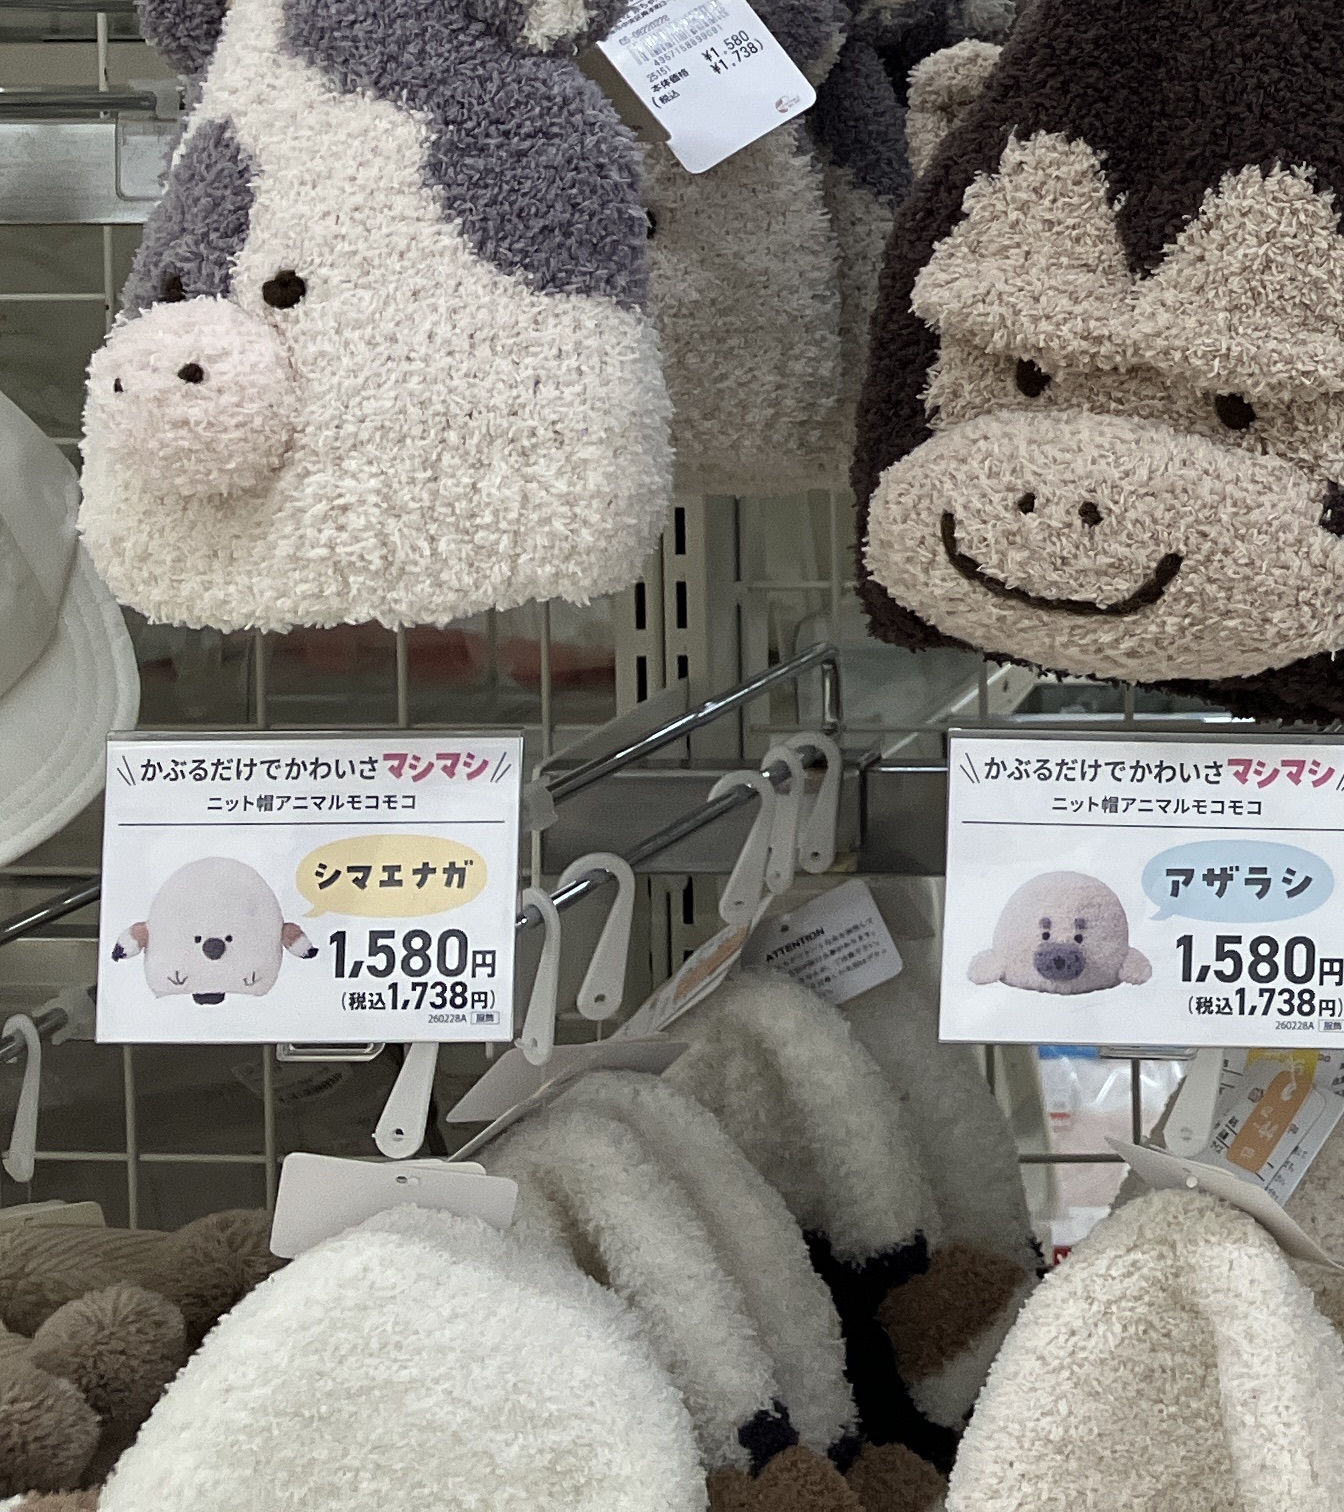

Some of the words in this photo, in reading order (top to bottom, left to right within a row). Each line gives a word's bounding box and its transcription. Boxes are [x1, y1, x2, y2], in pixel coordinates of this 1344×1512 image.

[140, 752, 490, 783] かぶるだけでかわいさマシマシ
[984, 757, 1336, 788] かぶるだけでかわいさマシマシ
[207, 795, 416, 812] ニット帽アニマルモコモコ
[1052, 797, 1262, 816] ニット帽アニマルモコモコ
[314, 859, 475, 890] シマエナガ
[1166, 866, 1313, 899] アザラシ
[329, 930, 496, 979] 1,580円
[766, 926, 825, 963] ATTENTION
[1176, 935, 1344, 986] 1,580円
